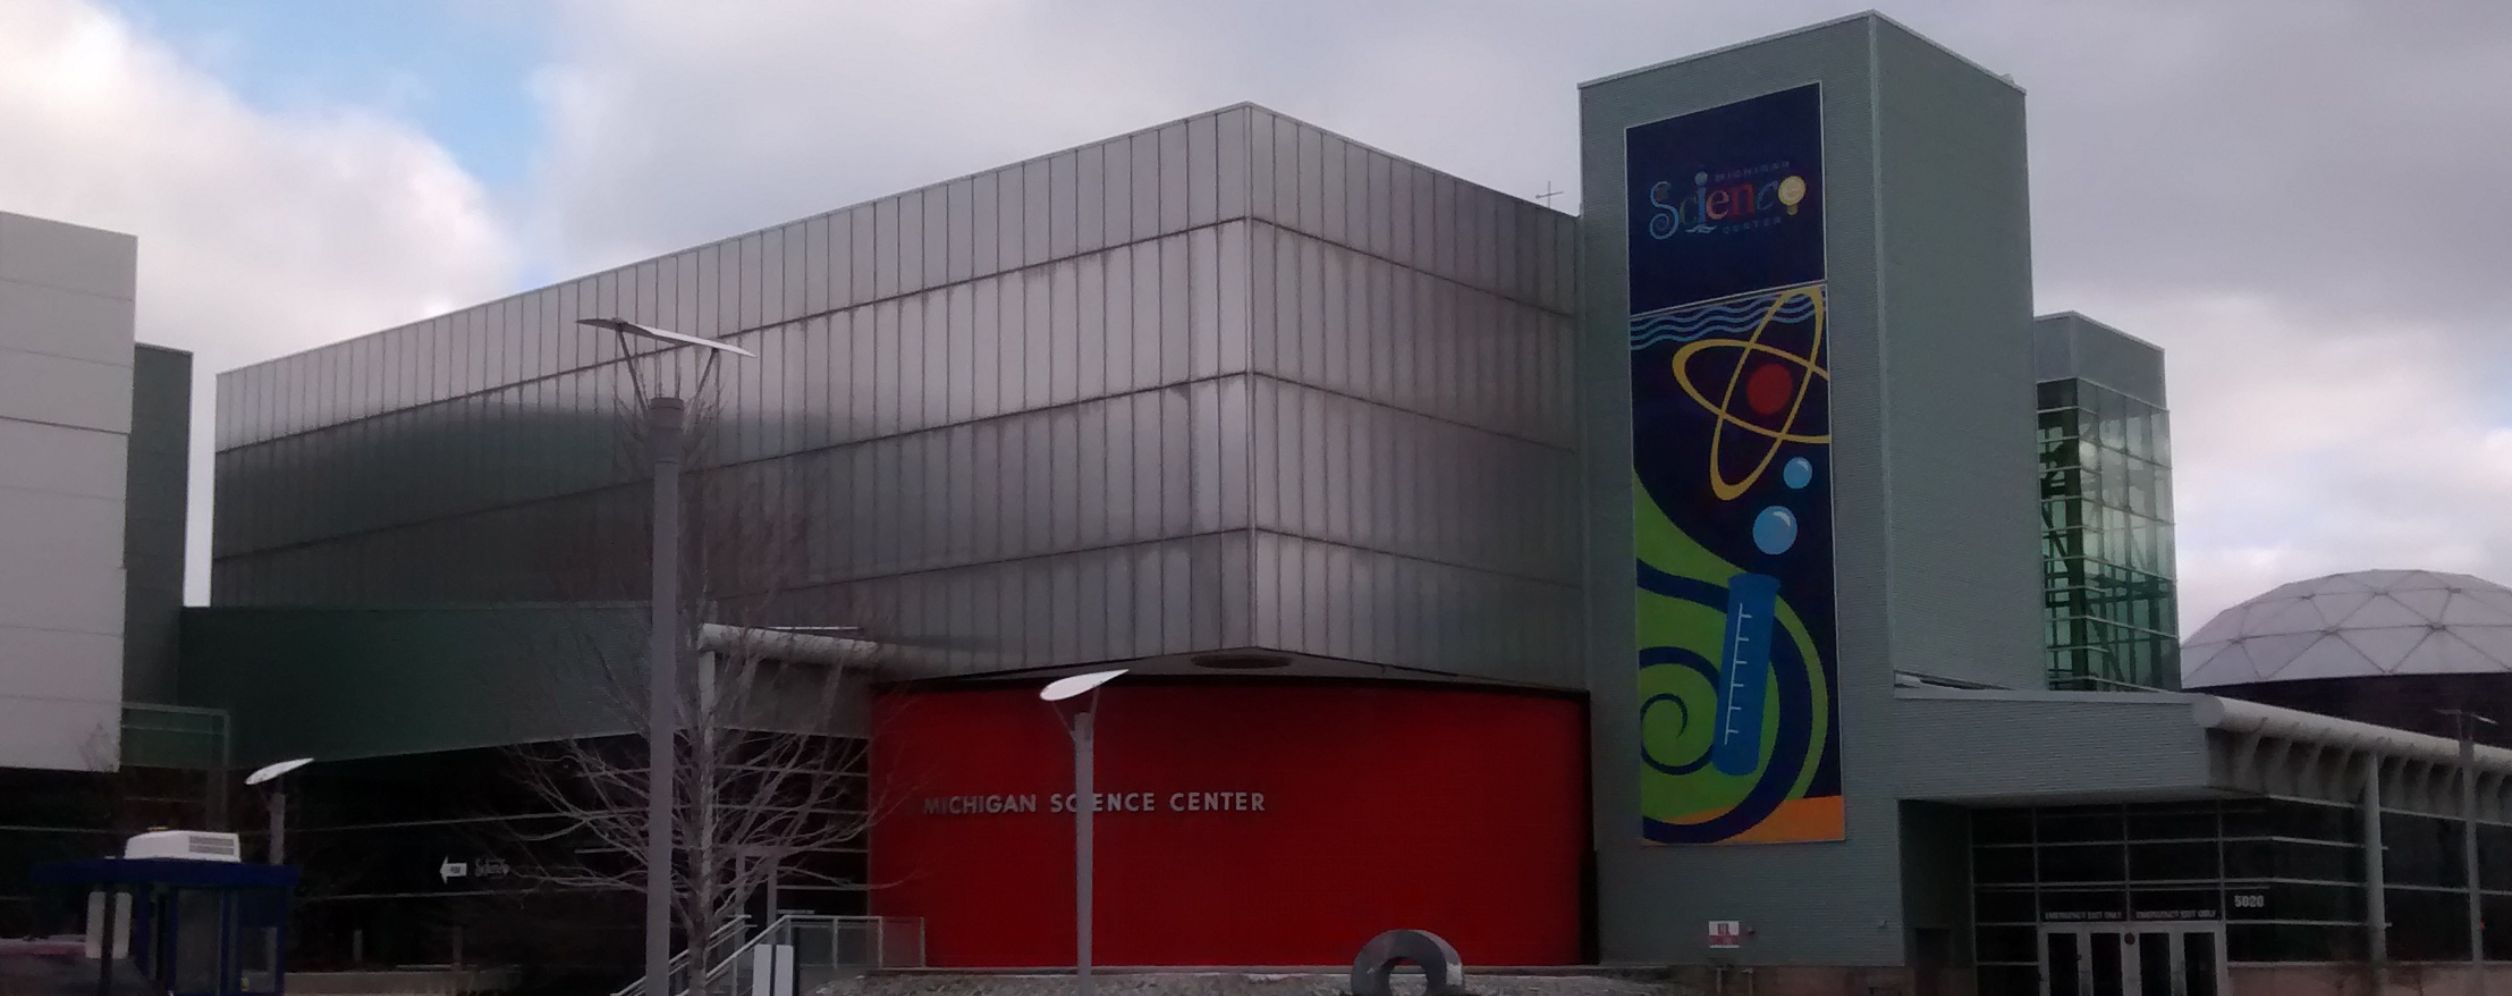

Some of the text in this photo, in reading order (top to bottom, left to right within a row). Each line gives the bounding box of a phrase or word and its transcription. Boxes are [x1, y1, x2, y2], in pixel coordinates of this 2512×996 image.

[1649, 170, 1807, 240] Science
[923, 791, 1266, 815] MICHIGAN SCENCE CENTER
